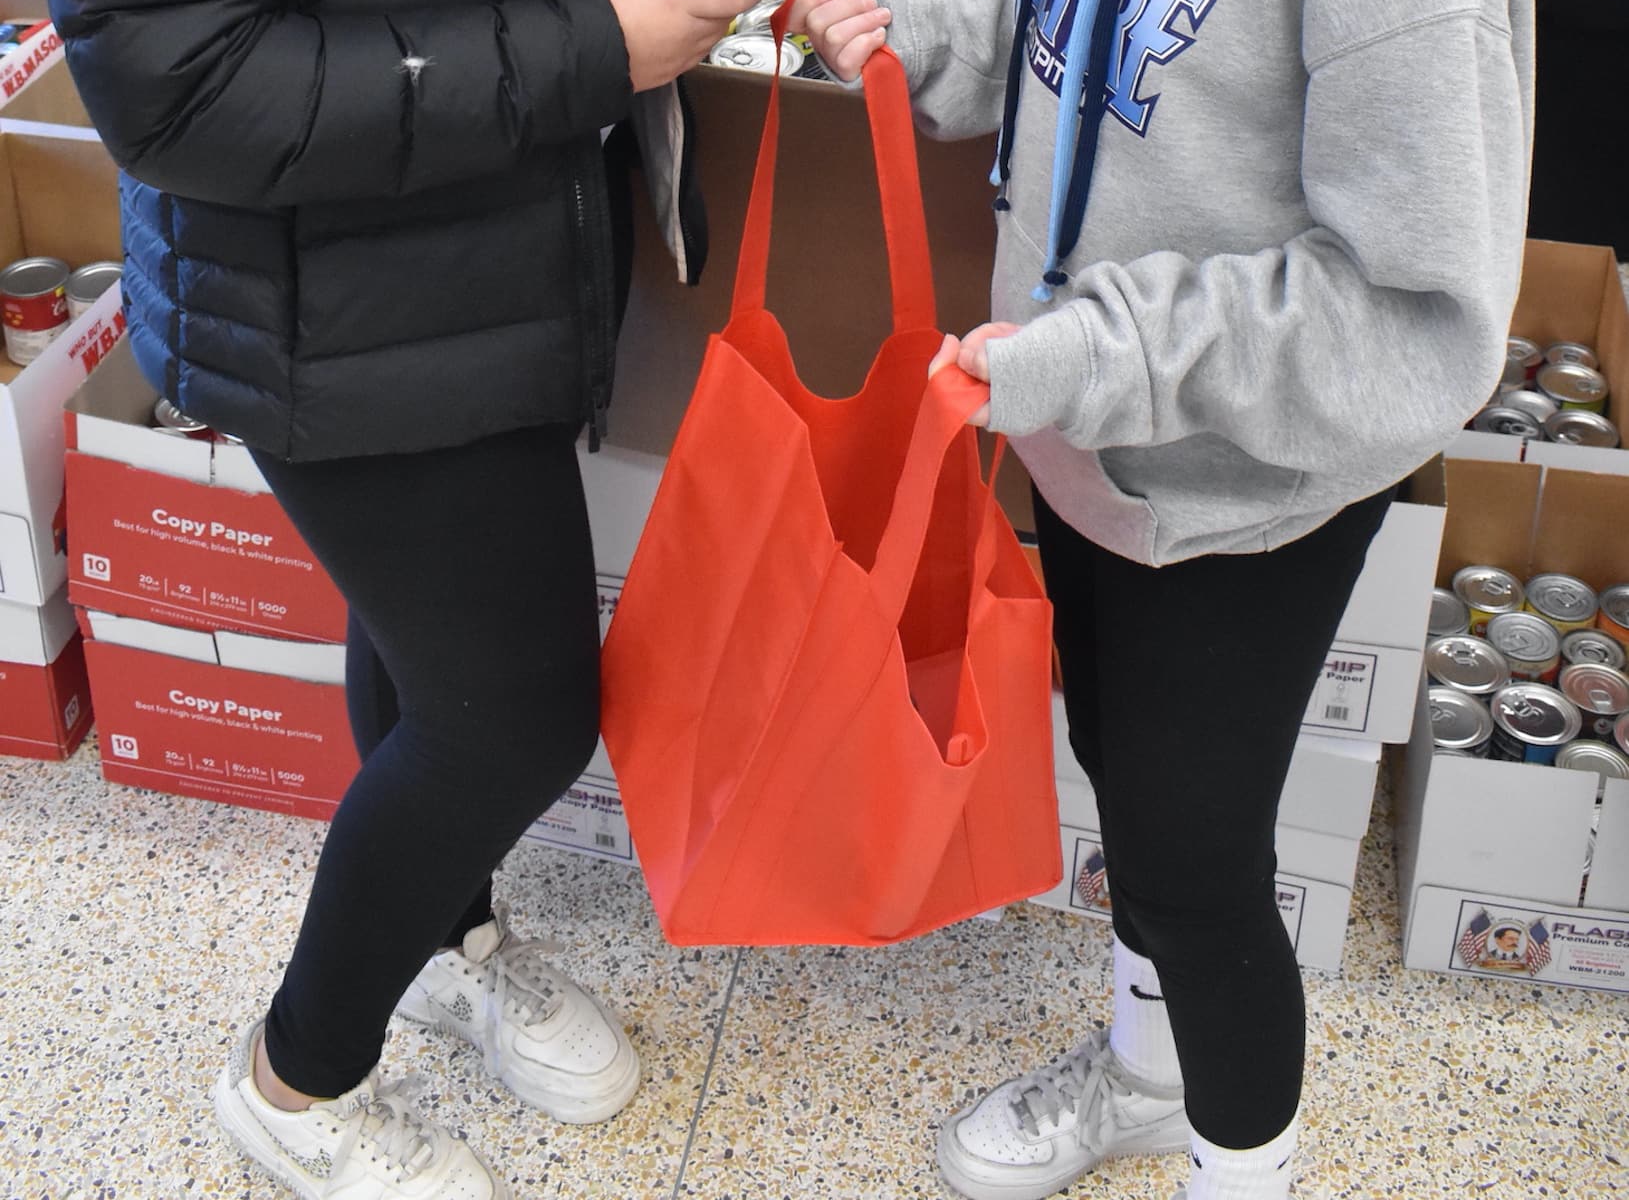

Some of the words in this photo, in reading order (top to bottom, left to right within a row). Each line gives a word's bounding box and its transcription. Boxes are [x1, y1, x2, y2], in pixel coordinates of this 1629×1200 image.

[152, 508, 206, 537] Copy
[211, 521, 273, 547] Paper
[114, 519, 134, 533] Best
[135, 523, 150, 535] for
[151, 527, 171, 541] high
[173, 534, 209, 550] volume,
[211, 540, 237, 555] black
[247, 548, 273, 563] white
[275, 554, 313, 571] printing
[86, 557, 108, 574] 10
[179, 583, 192, 594] 92
[258, 601, 287, 615] 5000
[1326, 671, 1366, 682] Paper
[169, 689, 220, 714] Copy
[223, 699, 283, 722] Paper
[135, 700, 155, 713] Best
[156, 704, 169, 715] for
[170, 706, 190, 719] high
[191, 712, 226, 726] volume,
[227, 718, 251, 730] black
[260, 724, 285, 736] white
[287, 728, 323, 743] printing
[115, 737, 135, 753] 10
[202, 758, 215, 768] 92
[277, 771, 305, 783] 5000
[1552, 922, 1629, 941] FLAG
[1552, 932, 1609, 946] Premium
